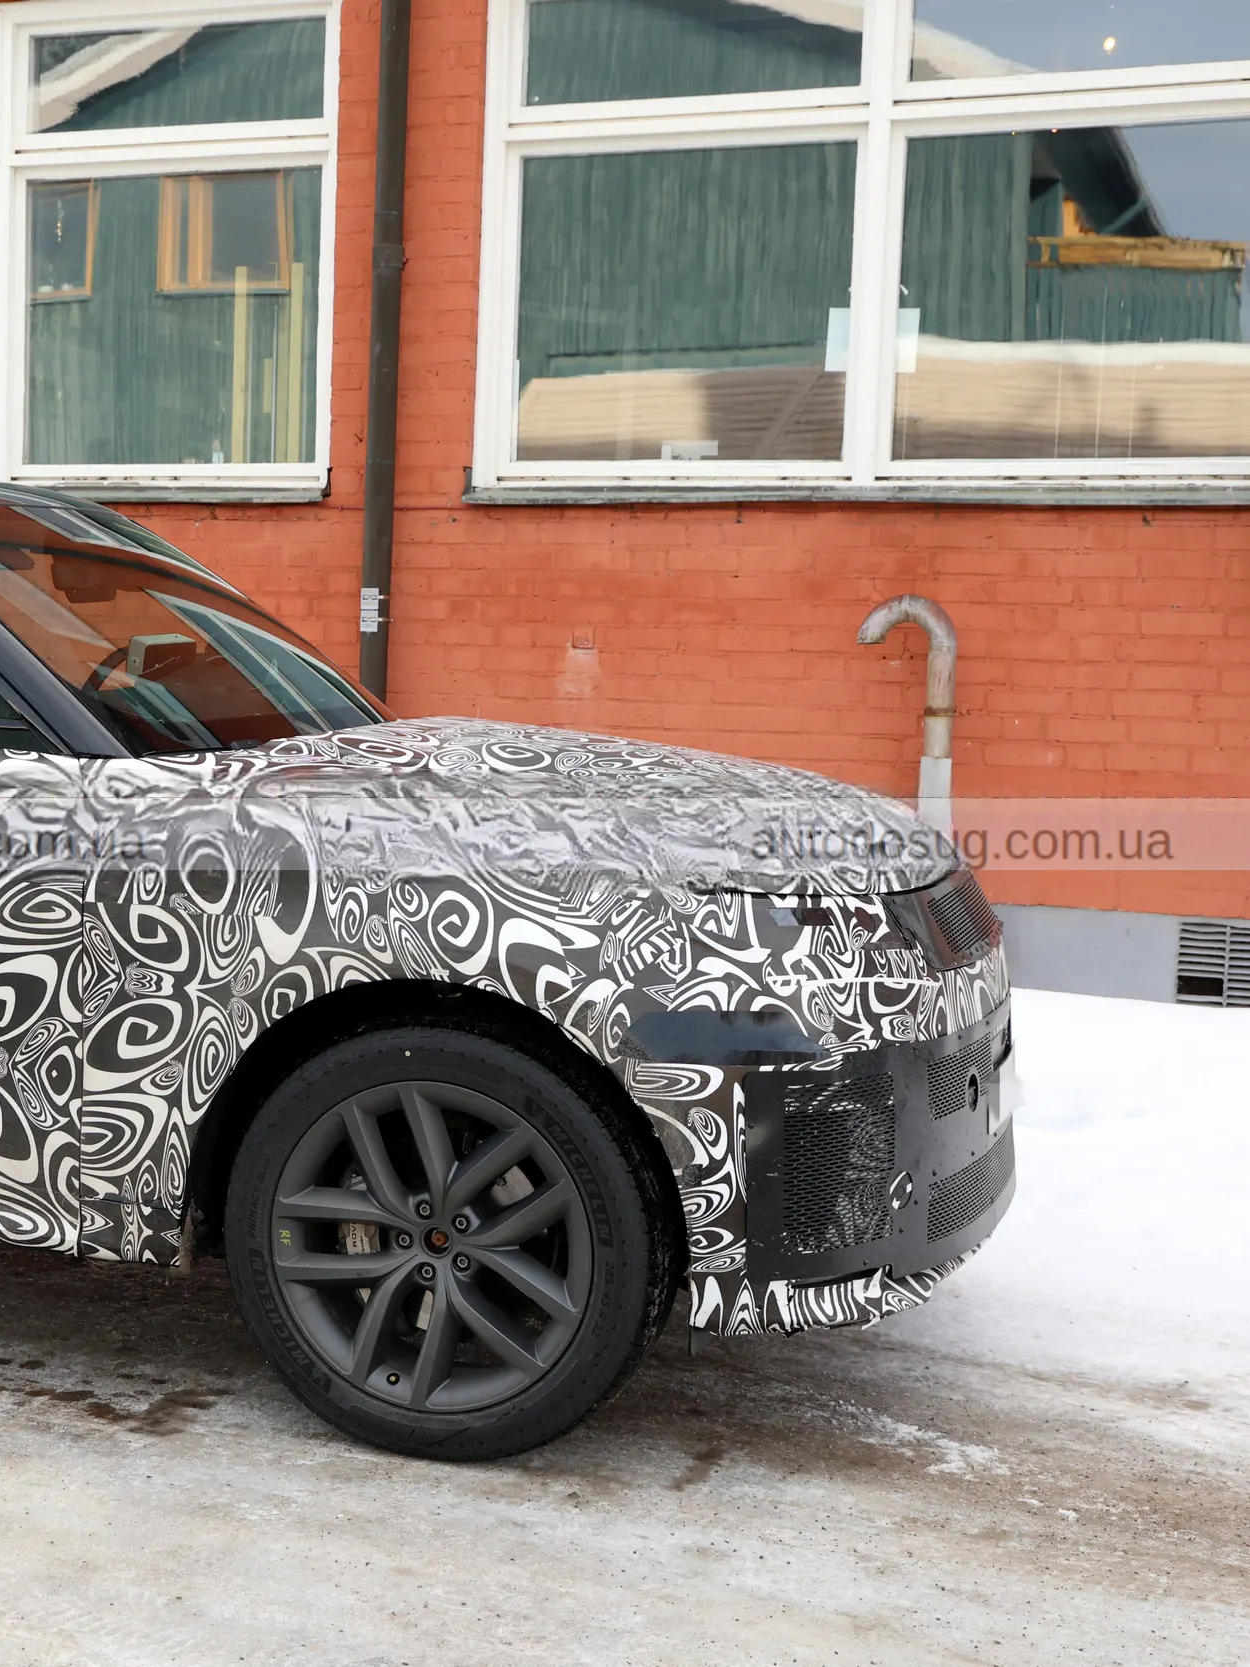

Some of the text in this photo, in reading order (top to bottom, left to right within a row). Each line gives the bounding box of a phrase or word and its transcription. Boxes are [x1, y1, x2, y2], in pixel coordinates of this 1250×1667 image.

[247, 1183, 259, 1239] PRIMACY
[548, 1124, 612, 1240] MICHELIN
[279, 1229, 291, 1247] RF
[251, 1256, 310, 1366] MICHELIN
